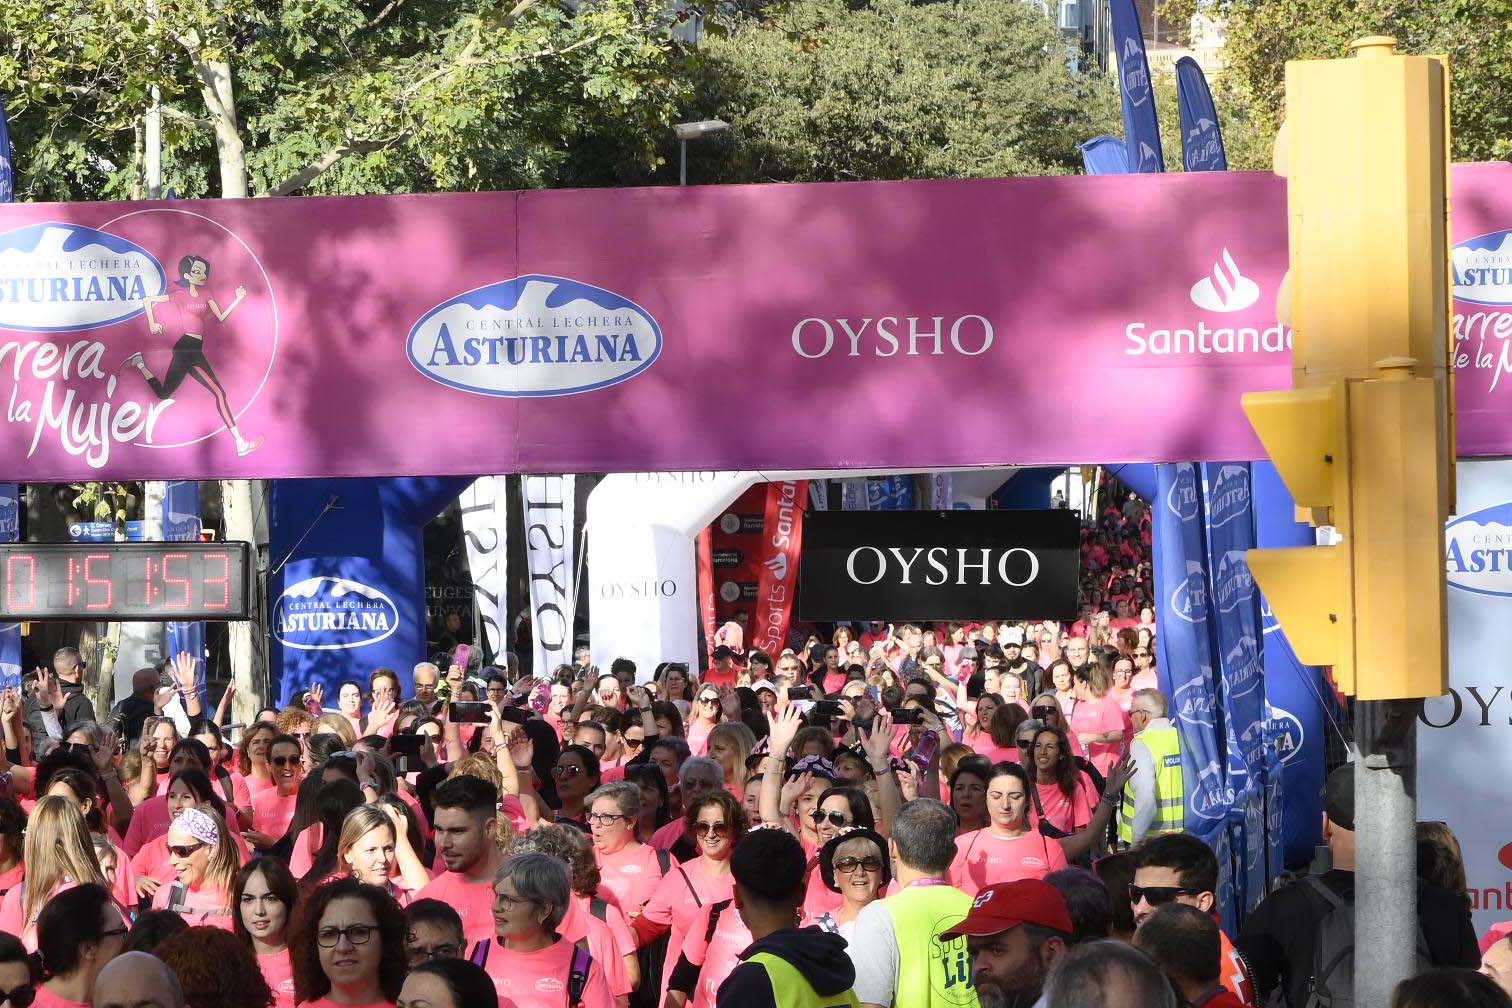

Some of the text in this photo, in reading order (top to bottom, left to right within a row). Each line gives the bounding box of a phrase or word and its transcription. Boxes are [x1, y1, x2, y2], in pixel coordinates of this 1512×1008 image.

[67, 258, 142, 269] LECHERA
[465, 315, 634, 331] CENTRAL LECHERA
[791, 314, 995, 360] OYSHO
[427, 322, 641, 368] ASTURIANA
[7, 384, 32, 423] la
[27, 374, 175, 468] Mujer
[845, 545, 1040, 587] OYSHO
[276, 605, 390, 634] ASTURIANA
[289, 601, 385, 611] CENTRAL LECHERA
